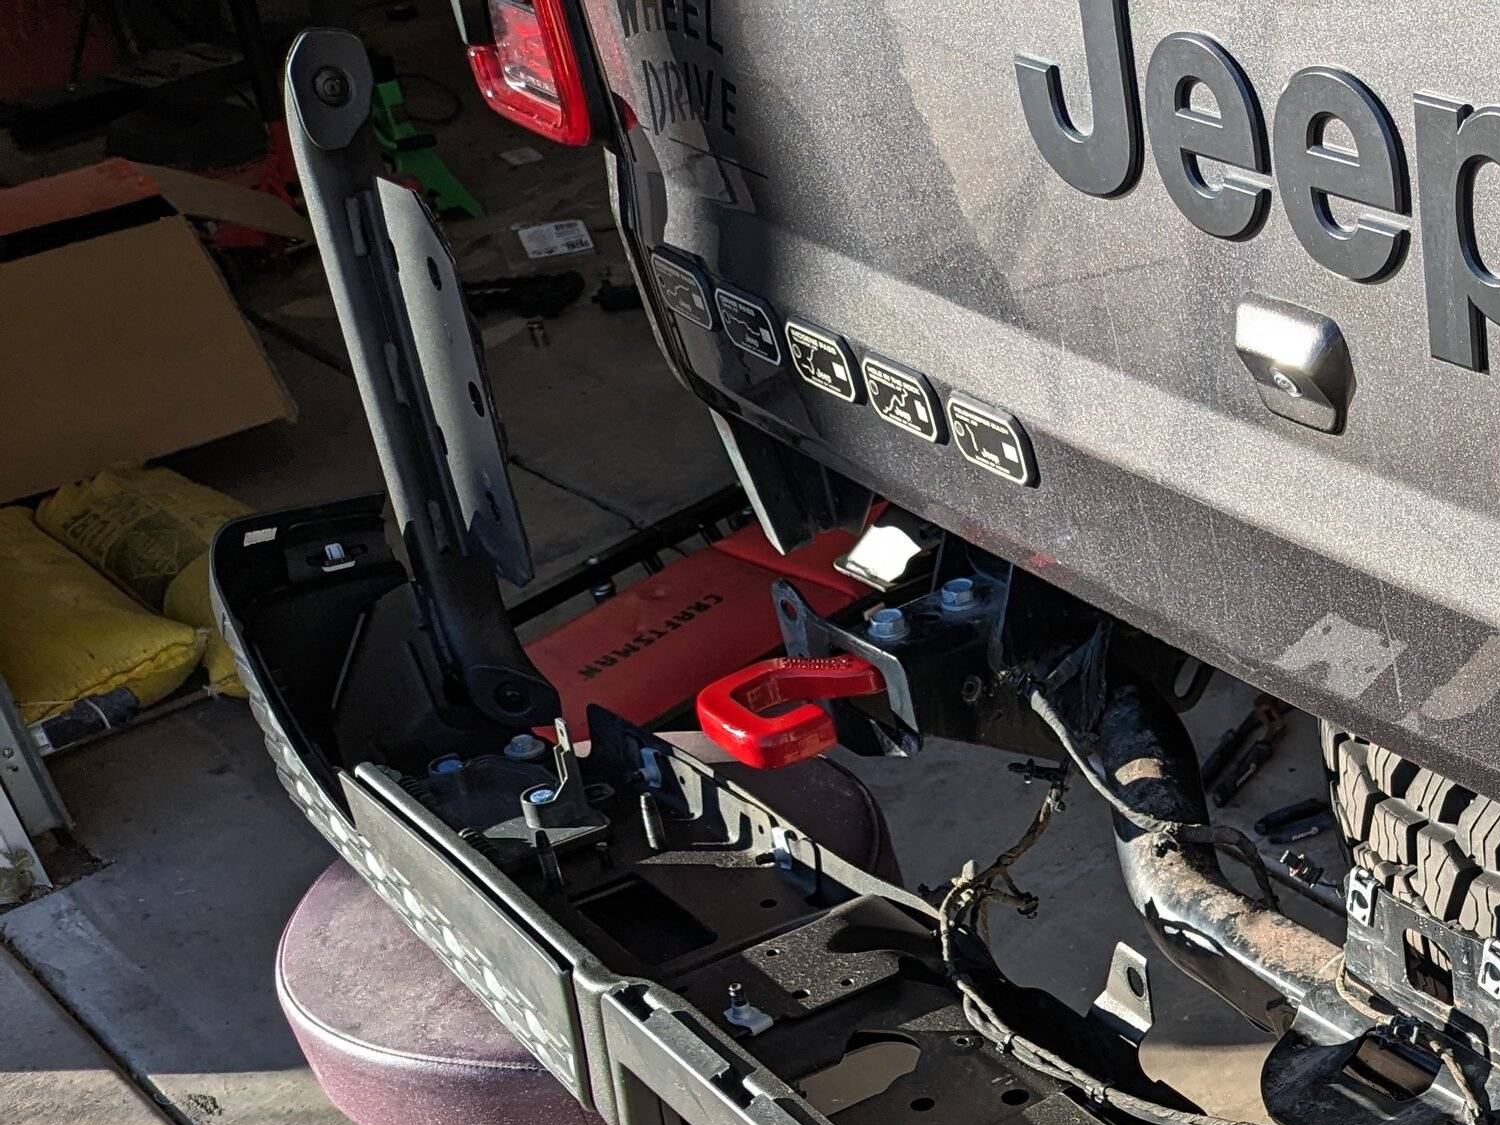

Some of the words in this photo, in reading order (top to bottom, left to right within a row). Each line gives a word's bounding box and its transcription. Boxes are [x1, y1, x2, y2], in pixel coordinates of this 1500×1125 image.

[617, 0, 723, 54] WHEEL
[641, 60, 737, 135] DRIVE
[577, 593, 724, 680] CRAFTSMAN
